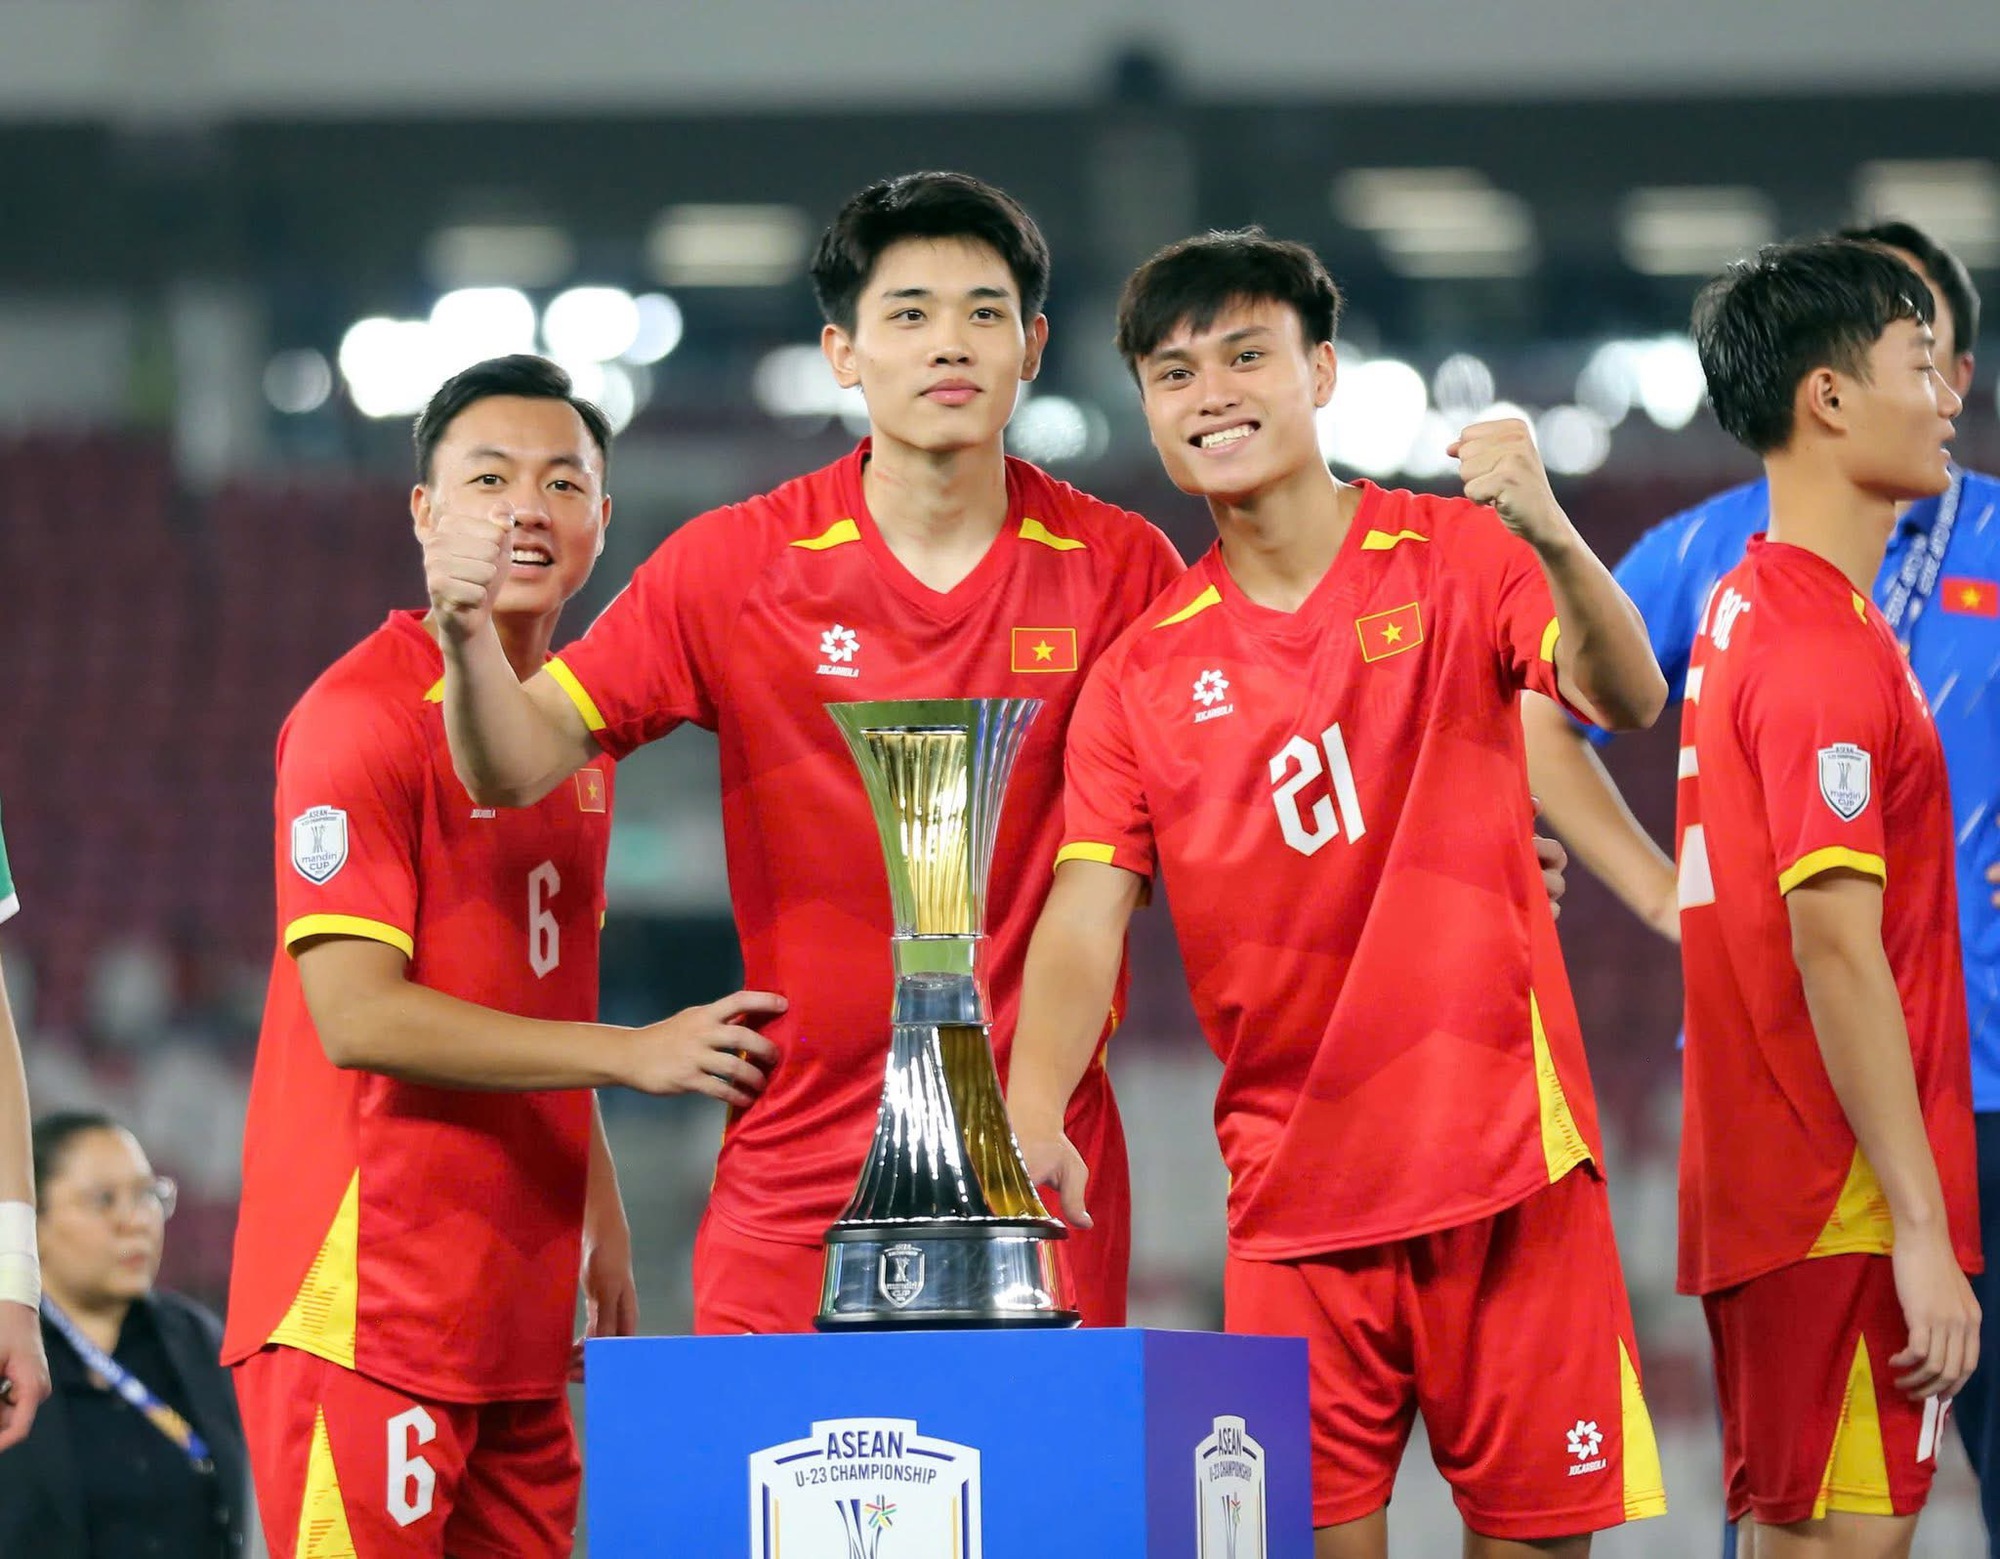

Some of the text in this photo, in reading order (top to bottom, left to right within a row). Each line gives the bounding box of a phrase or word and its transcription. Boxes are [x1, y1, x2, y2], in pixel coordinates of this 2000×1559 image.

[1269, 721, 1367, 857] 21
[309, 861, 330, 870] CUP
[528, 859, 561, 980] 6
[827, 1430, 904, 1461] ASEAN
[1218, 1427, 1242, 1457] ASEAN
[387, 1405, 437, 1528] 6
[795, 1463, 937, 1488] U-23 CHAMPIONSHIP
